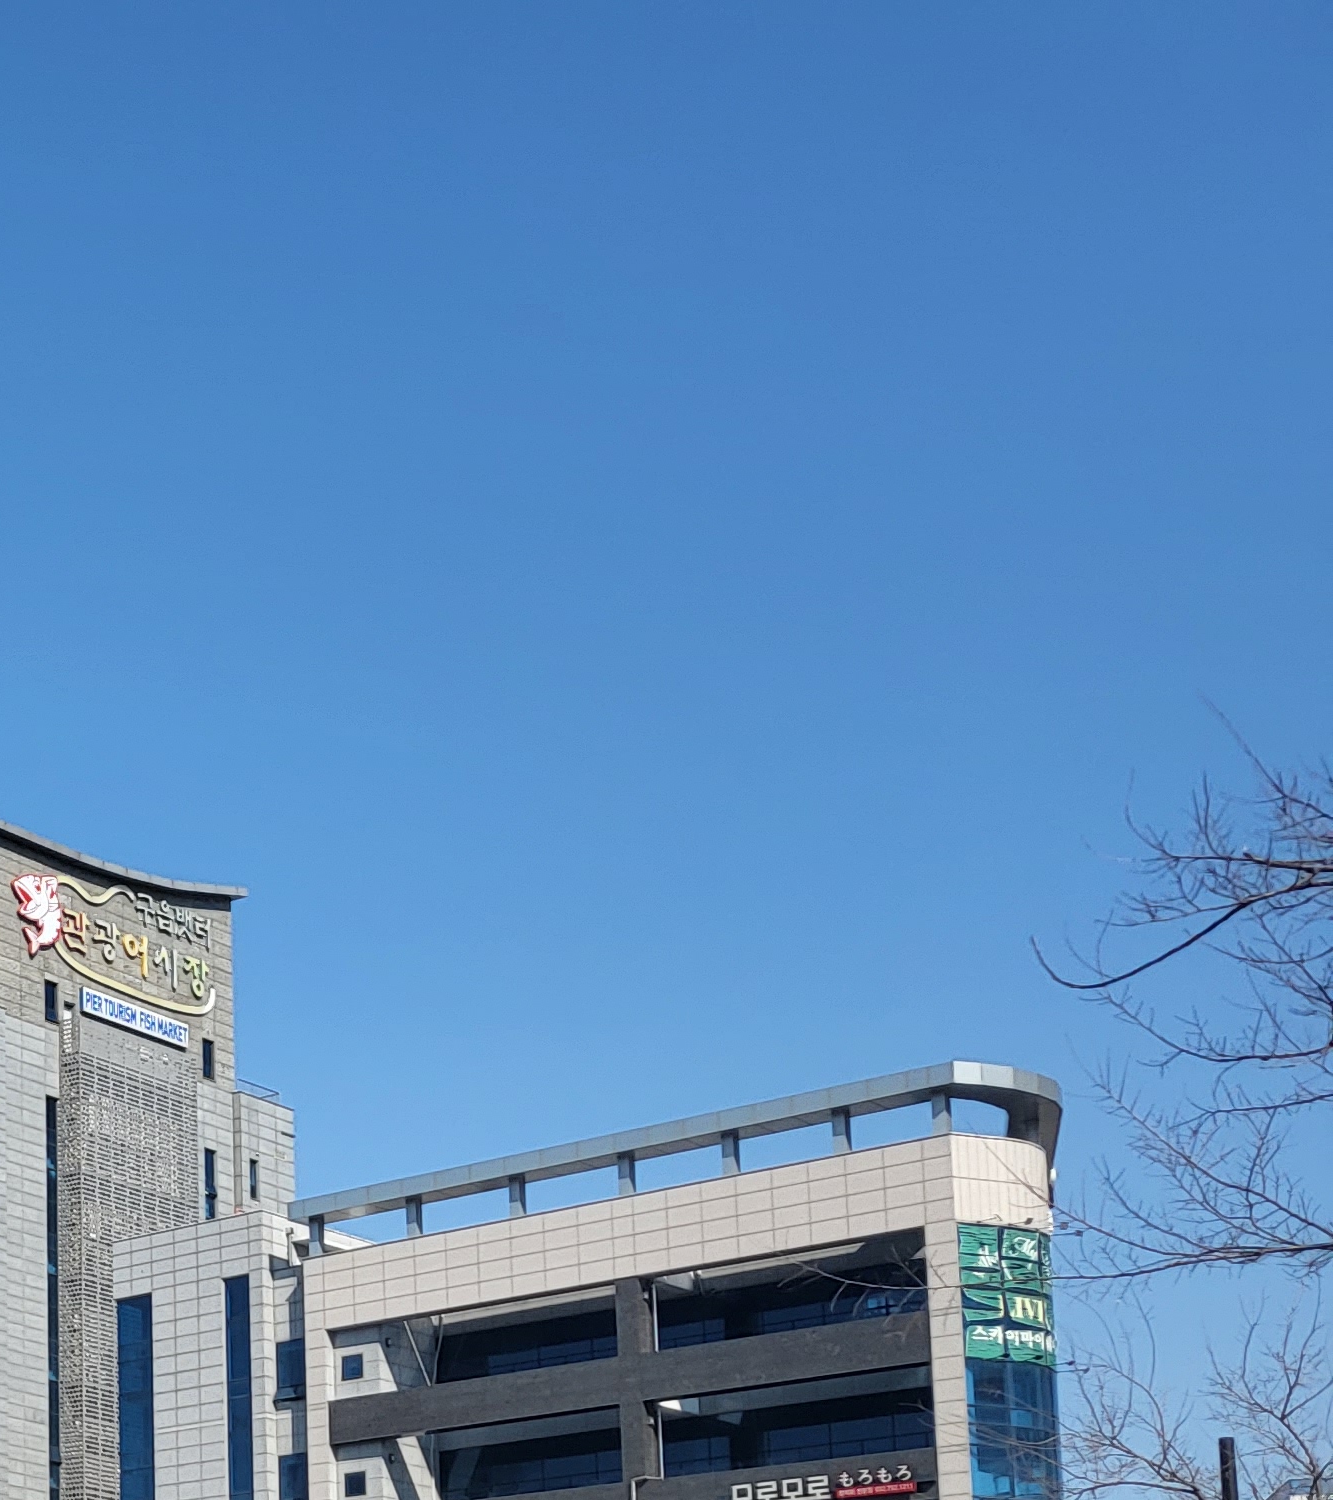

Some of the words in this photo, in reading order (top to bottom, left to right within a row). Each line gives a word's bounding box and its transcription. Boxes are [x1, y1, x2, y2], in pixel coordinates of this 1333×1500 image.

[135, 892, 212, 951] 구읍뱃터
[61, 908, 210, 999] 관광어시장
[85, 991, 103, 1014] PIER
[104, 998, 137, 1026] TOURISM
[139, 1010, 157, 1033] FISH
[157, 1017, 188, 1043] MARKET
[838, 1464, 912, 1488] もろもろ
